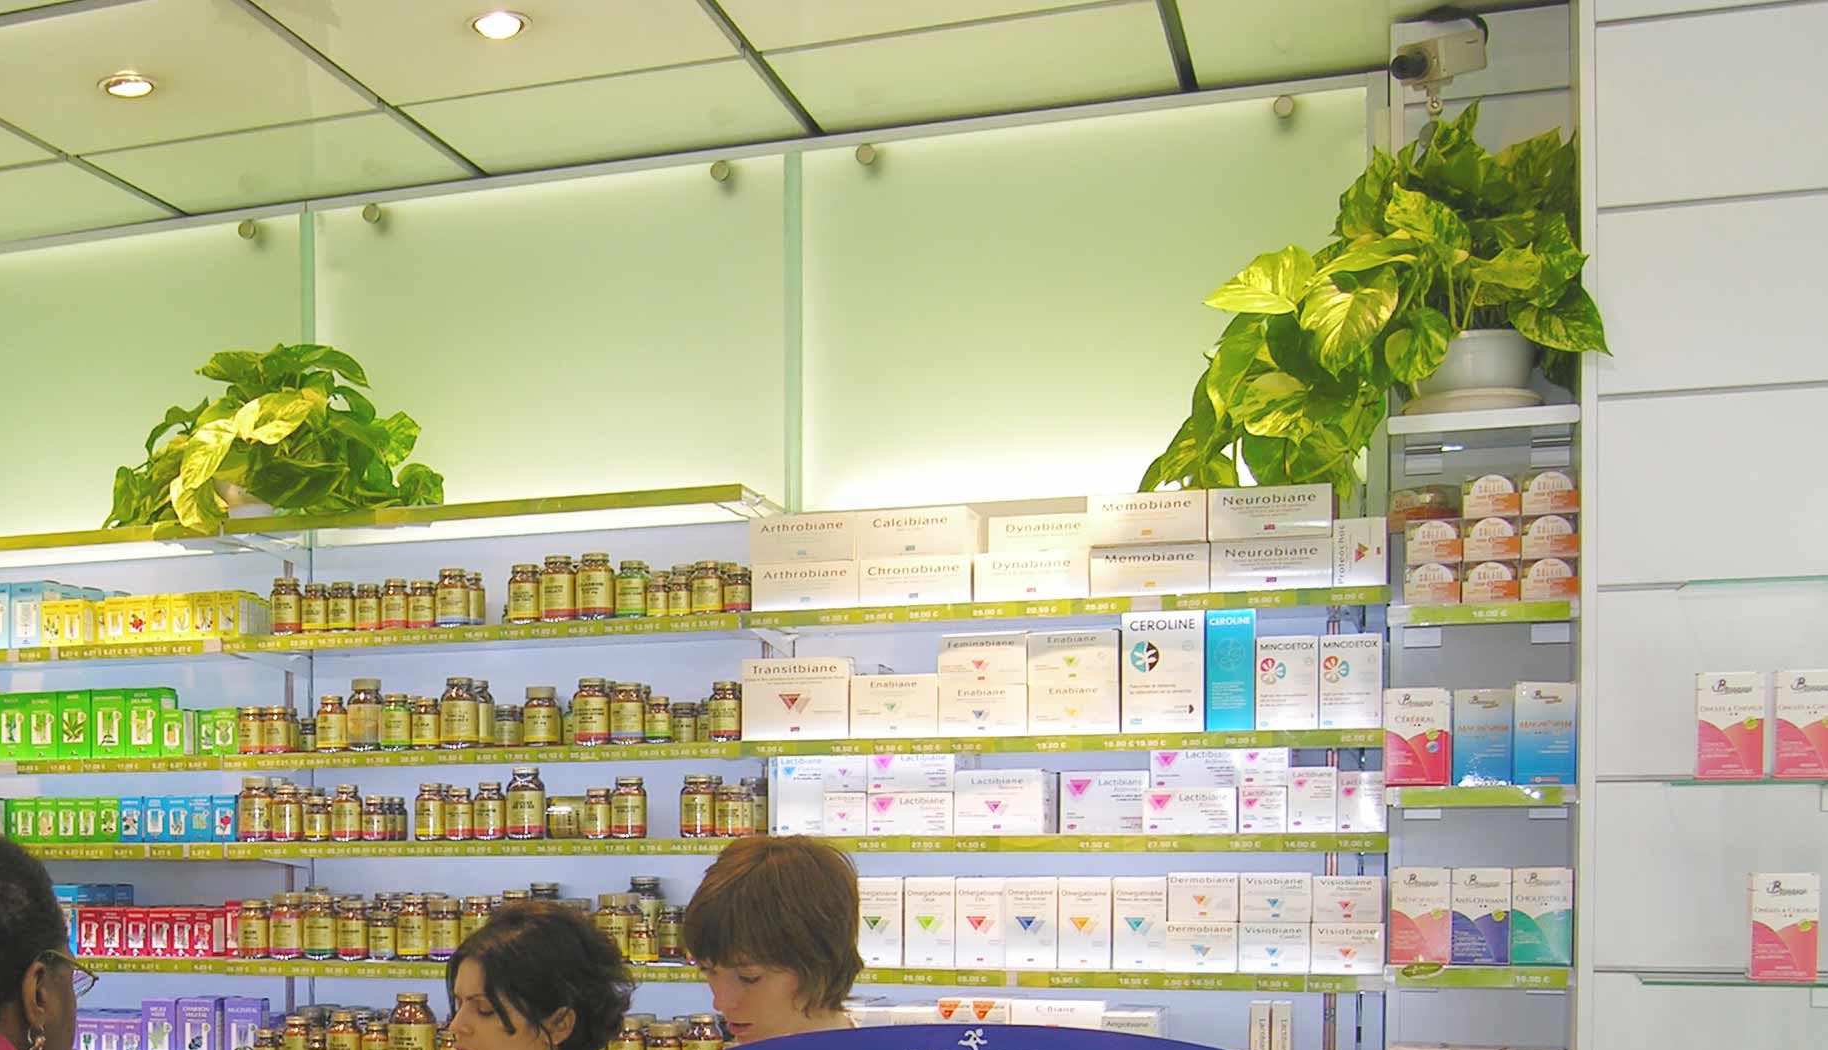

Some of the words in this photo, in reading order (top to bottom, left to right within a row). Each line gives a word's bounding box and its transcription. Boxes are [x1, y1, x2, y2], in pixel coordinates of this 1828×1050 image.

[1101, 497, 1193, 513] Memobiane
[1221, 491, 1318, 508] Neurobiane
[760, 518, 844, 534] Arthrobiane
[872, 514, 949, 530] Calcibiane
[1005, 518, 1081, 537] Dynabiane
[867, 562, 960, 577] Chronobiane
[1129, 617, 1196, 633] CEROLINE
[1258, 641, 1315, 652] MINCIDETOX
[751, 661, 838, 676] Transitbiane
[970, 776, 1025, 787] Lactibiane
[1167, 874, 1237, 886] Dermobiane
[1244, 925, 1303, 937] Visiobiane
